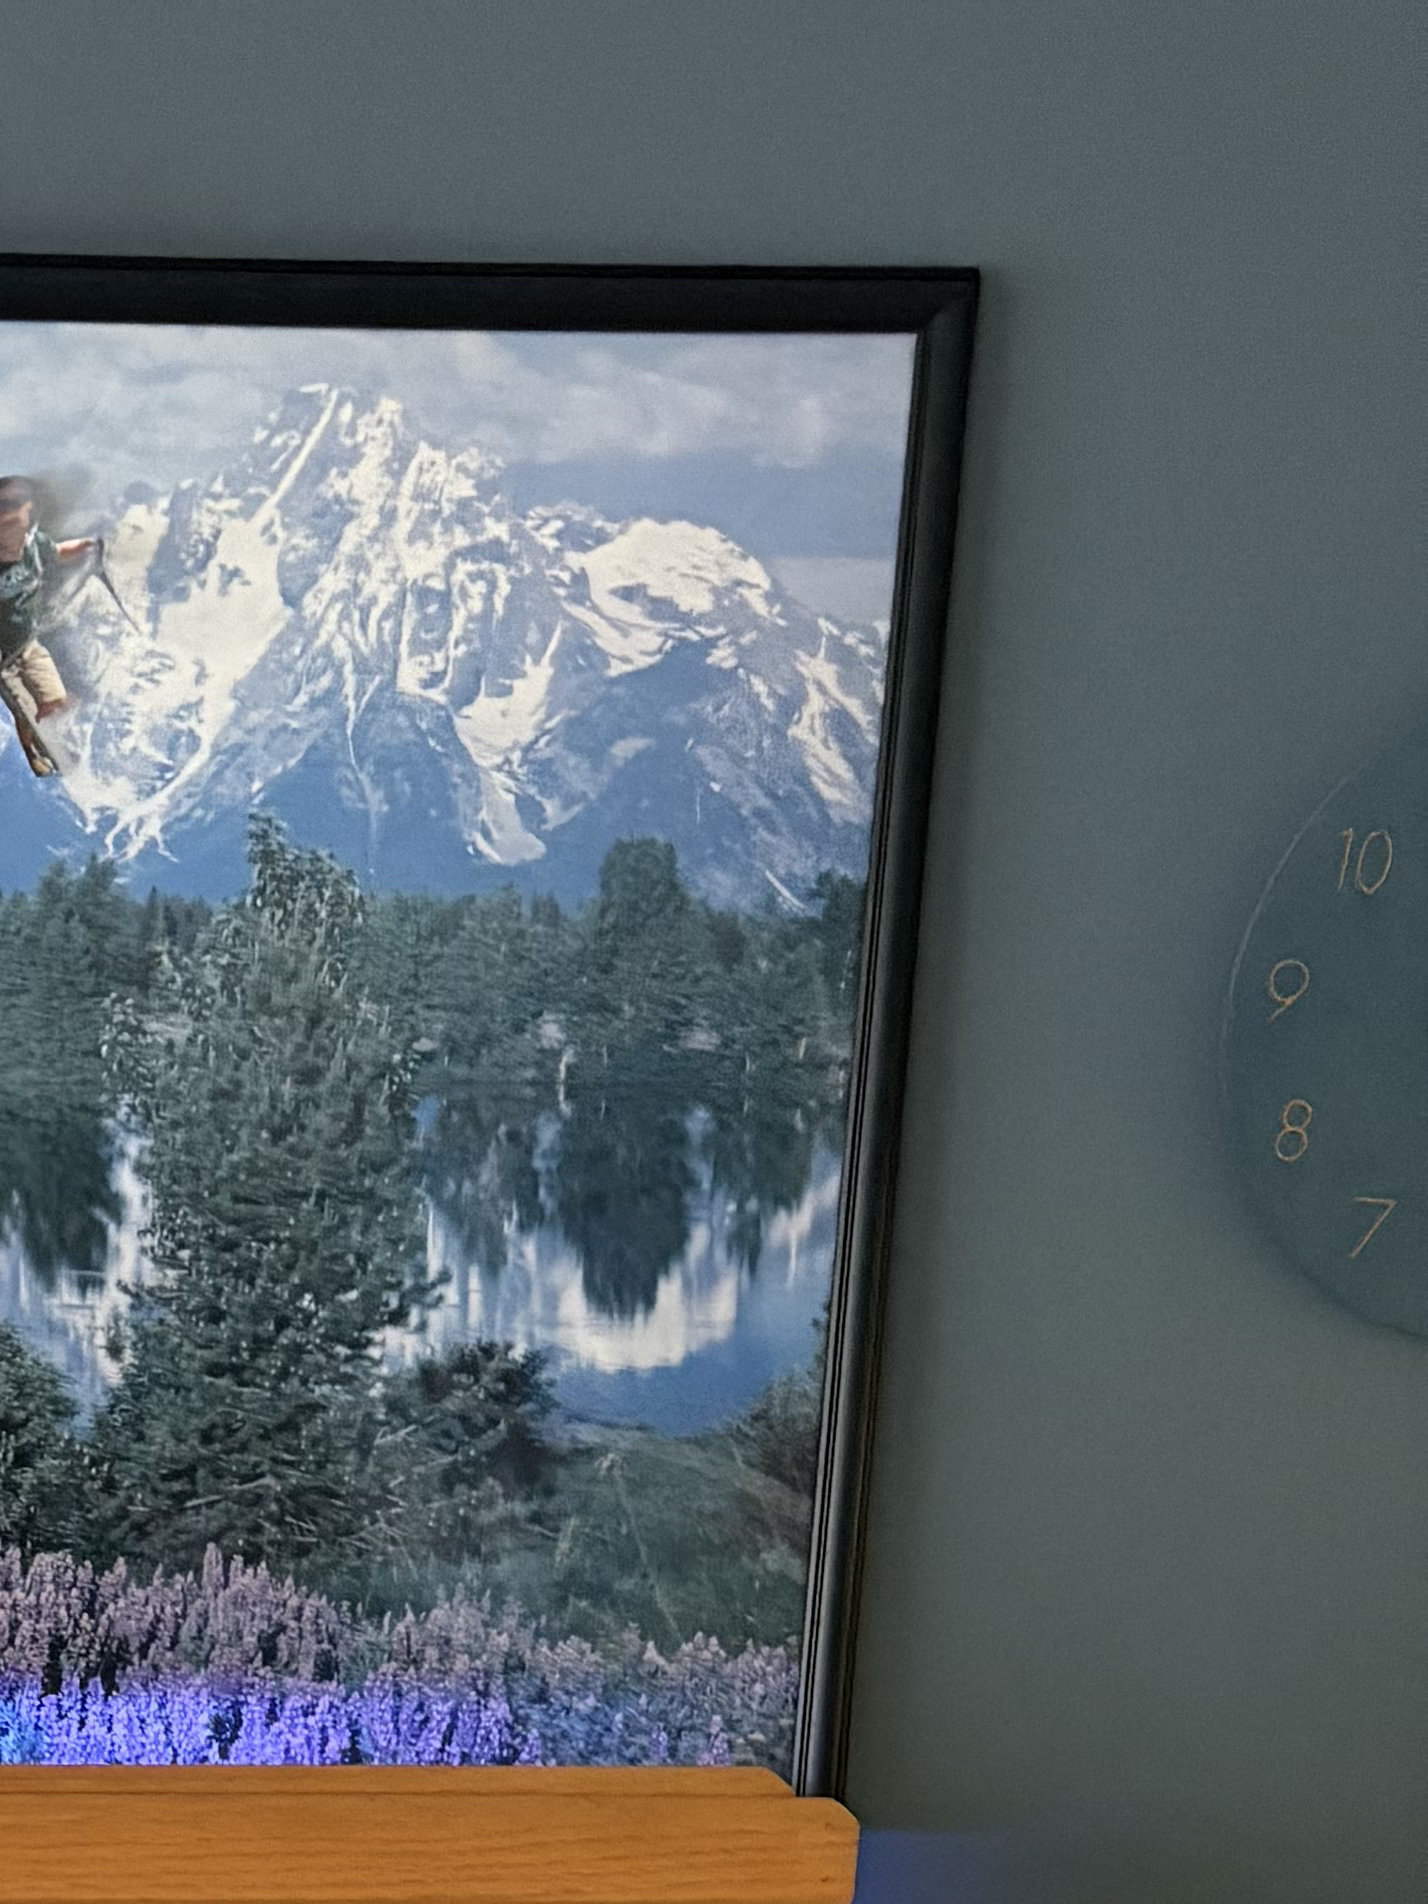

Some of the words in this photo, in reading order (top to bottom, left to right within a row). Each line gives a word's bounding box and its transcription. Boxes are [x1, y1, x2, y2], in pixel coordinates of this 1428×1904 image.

[1338, 827, 1393, 895] 10
[1268, 959, 1310, 1024] 9
[1275, 1100, 1313, 1162] 8
[1349, 1196, 1398, 1259] 7
